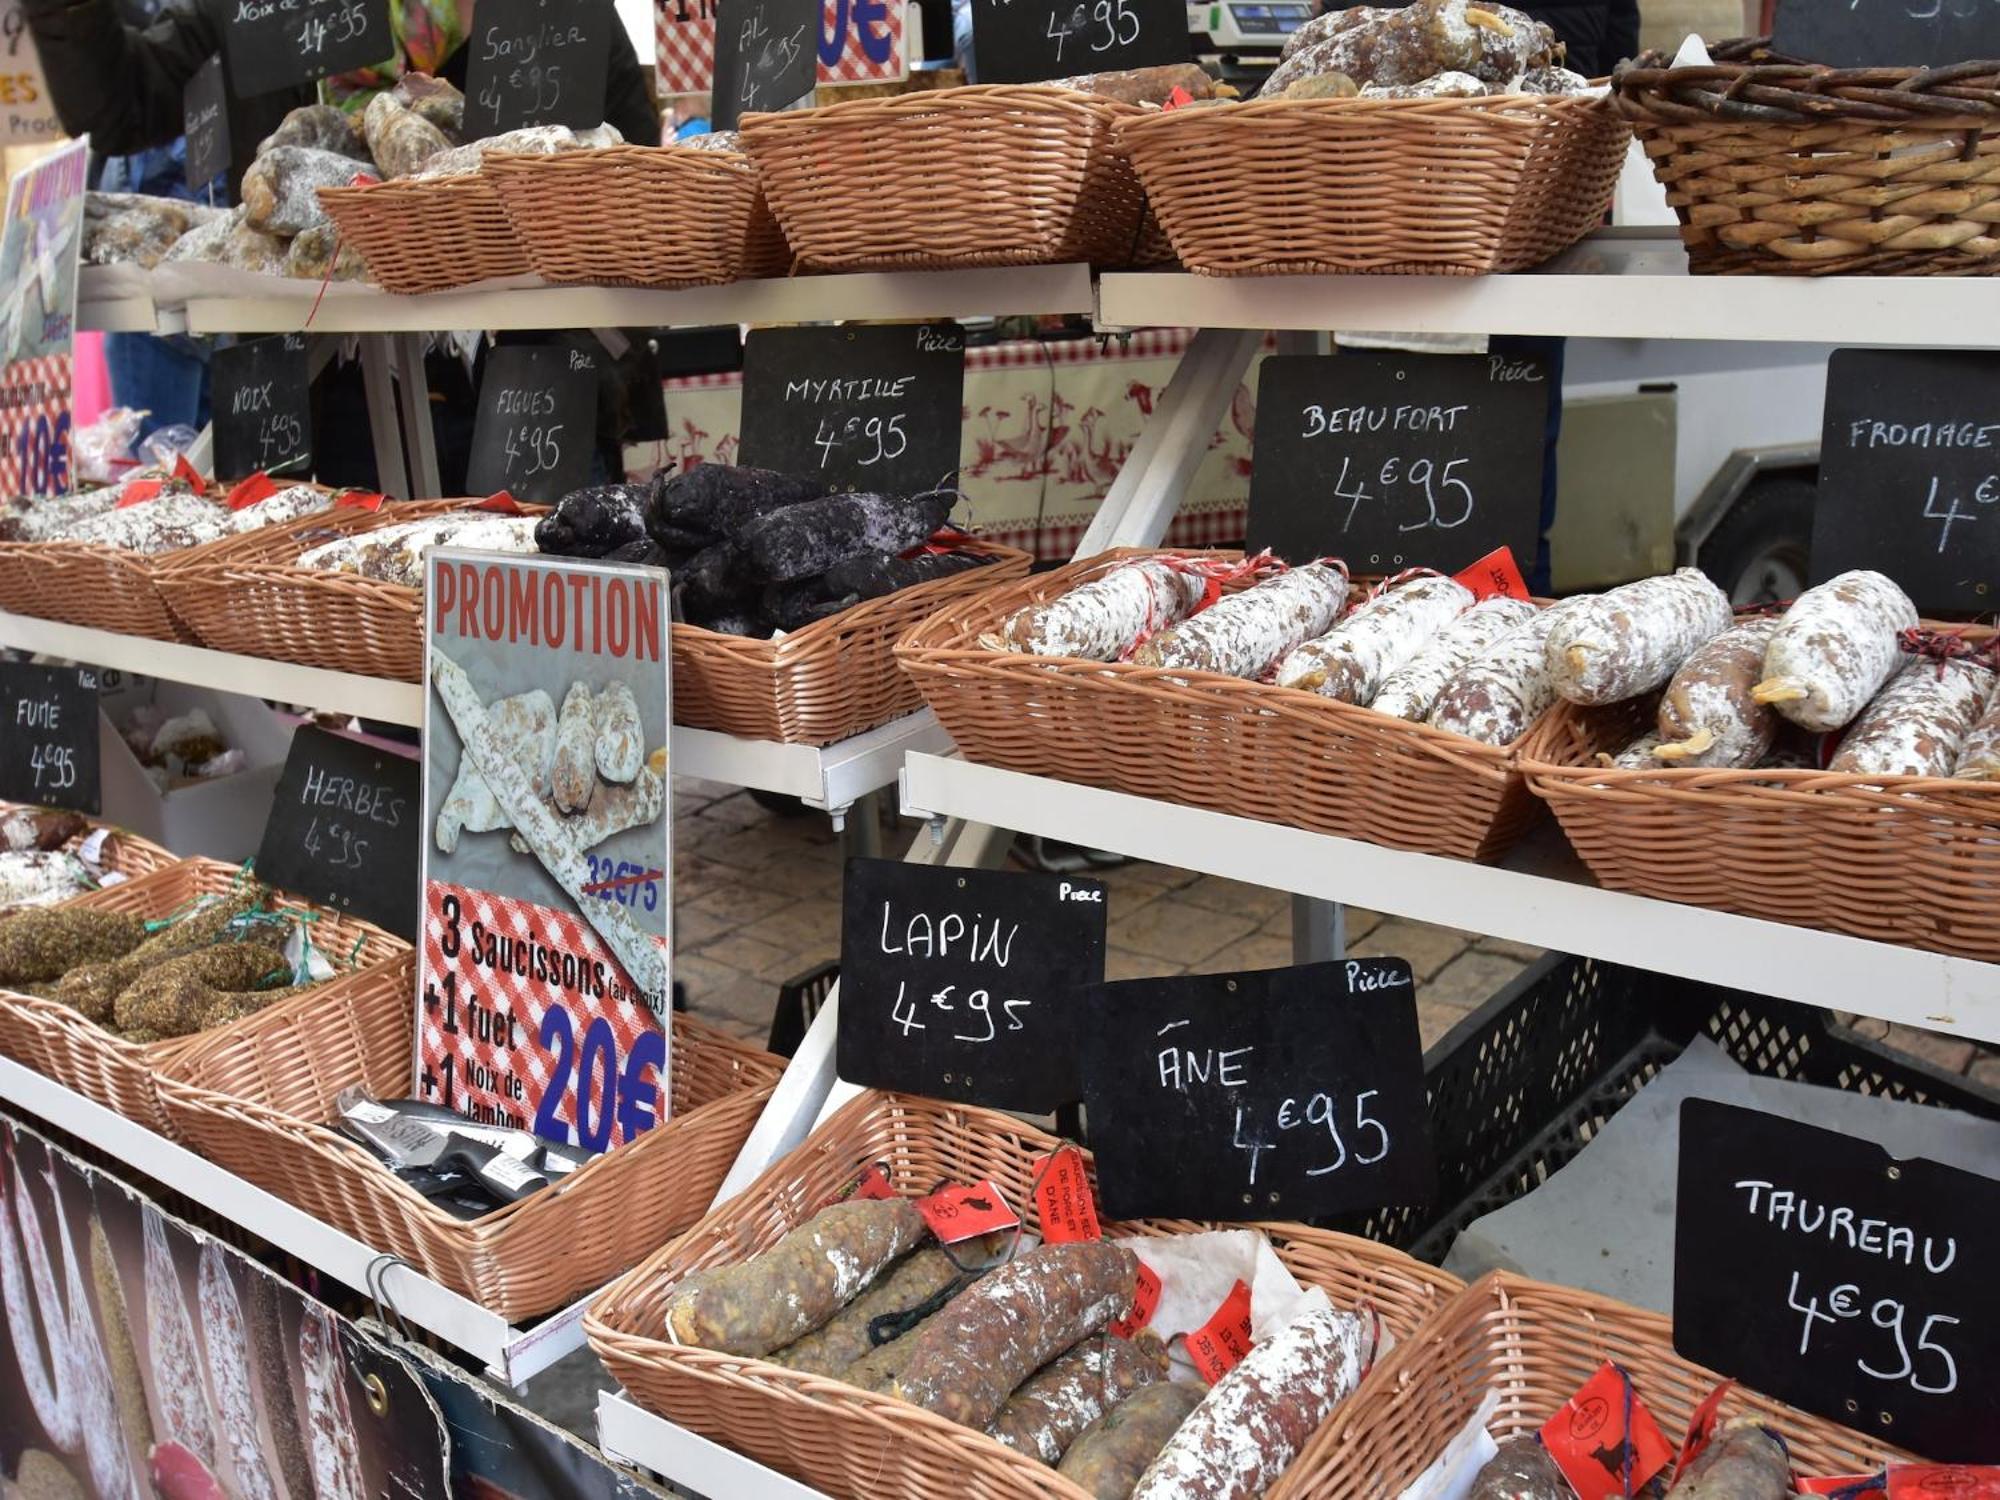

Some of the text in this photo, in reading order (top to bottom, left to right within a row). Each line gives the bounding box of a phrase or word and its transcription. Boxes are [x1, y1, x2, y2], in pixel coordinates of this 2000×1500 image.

[496, 387, 555, 416] FIGUES
[785, 375, 916, 403] MYRTILLE
[504, 424, 564, 476] 4€95
[814, 413, 908, 469] 4€95
[1302, 404, 1469, 438] BEAUFORT
[1850, 418, 2000, 449] FROMAGE
[1334, 457, 1473, 532] 4€95
[436, 561, 660, 662] PROMOTION
[17, 693, 61, 729] FUMÉ
[30, 743, 76, 788] 4€95
[302, 765, 406, 827] HERBES
[304, 817, 369, 869] 4€95
[442, 894, 461, 958] 3
[471, 919, 605, 1000] Saucissons
[423, 971, 518, 1051] +1 fuet
[891, 980, 1032, 1042] 4€95
[421, 1053, 523, 1108] +1 Noix de
[533, 1002, 666, 1154] 20€
[1232, 1089, 1389, 1186] 4€95
[1735, 1181, 1957, 1274] TAUREAU
[1788, 1271, 1960, 1394] 4€95
